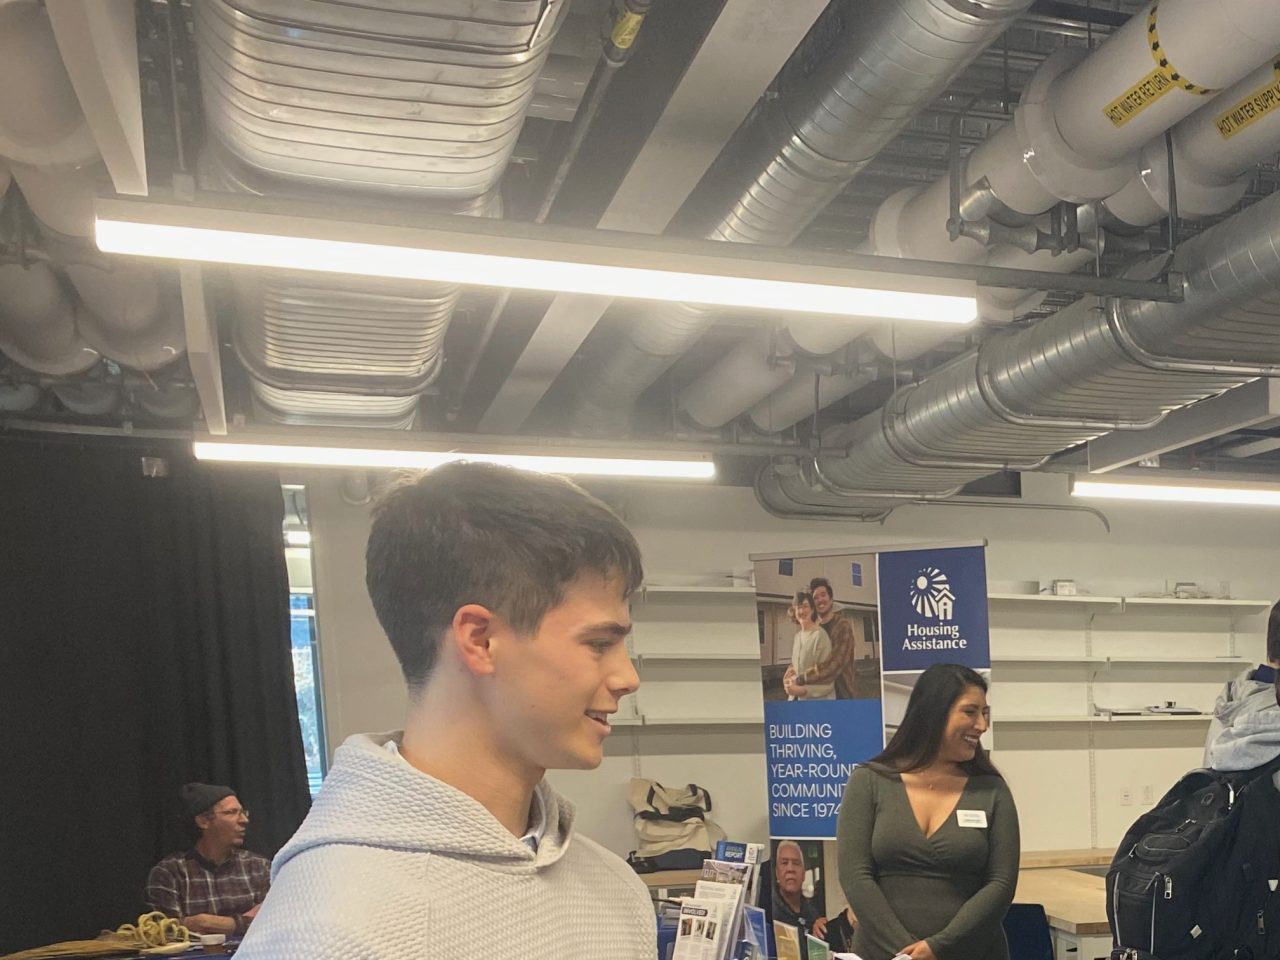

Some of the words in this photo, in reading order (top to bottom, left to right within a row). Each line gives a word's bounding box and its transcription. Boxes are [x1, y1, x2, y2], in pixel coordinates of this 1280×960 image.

[1106, 106, 1125, 124] HOT
[1118, 91, 1147, 114] WATER
[1139, 71, 1171, 99] RETURN
[1217, 116, 1235, 136] HOT
[1231, 102, 1258, 126] WATER
[907, 622, 960, 639] Housing
[902, 636, 967, 650] Assistance
[769, 723, 832, 739] BUILDING
[769, 743, 837, 760] THRIVING,
[772, 803, 809, 818] SINCE
[812, 802, 841, 818] 1974
